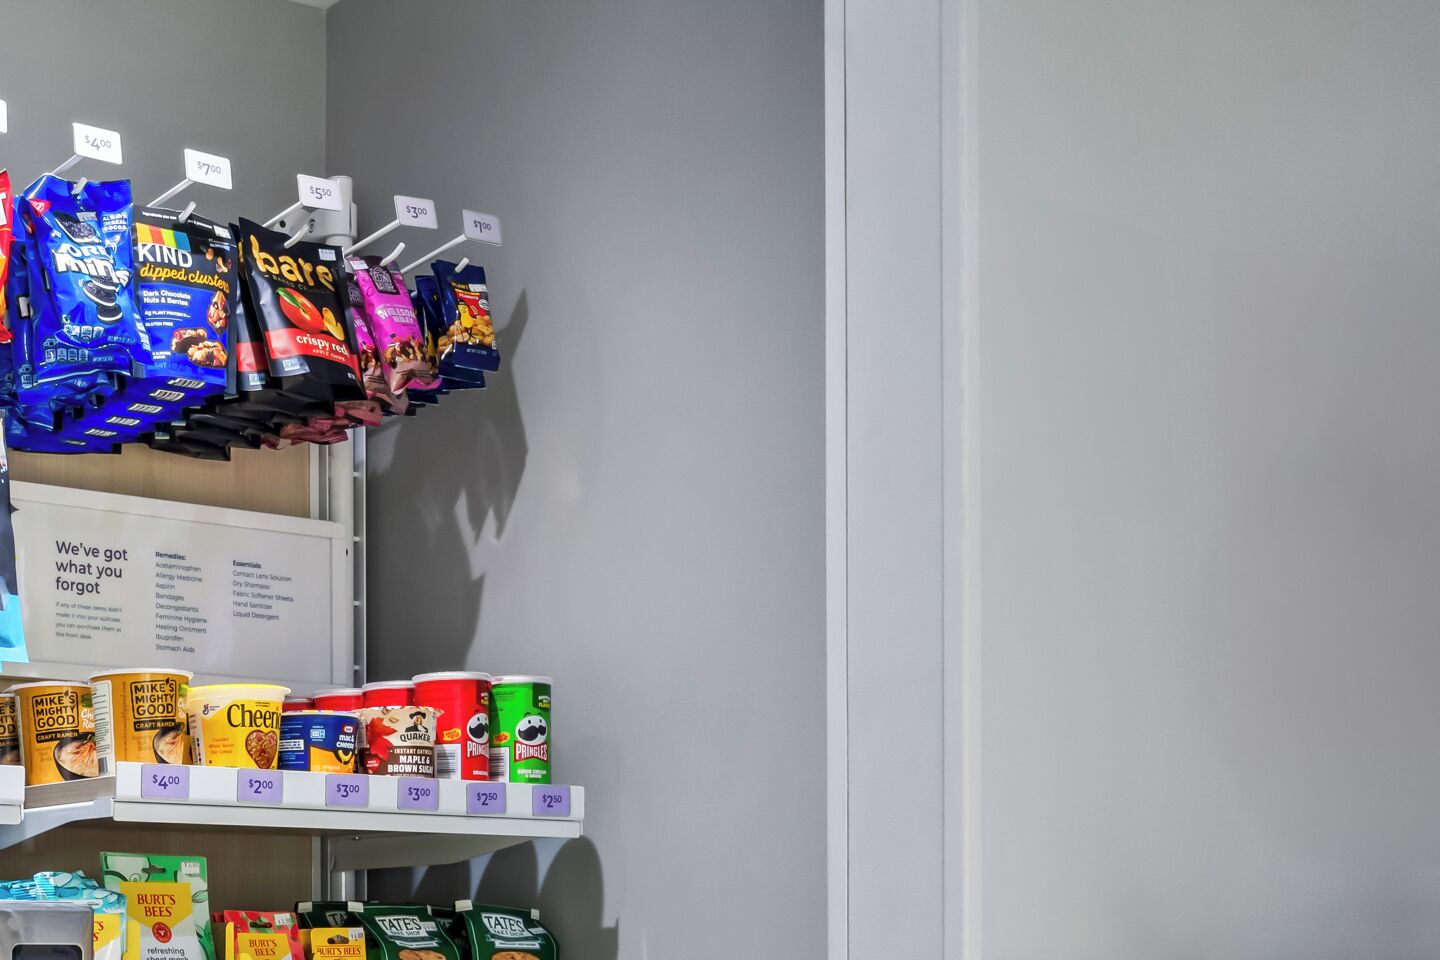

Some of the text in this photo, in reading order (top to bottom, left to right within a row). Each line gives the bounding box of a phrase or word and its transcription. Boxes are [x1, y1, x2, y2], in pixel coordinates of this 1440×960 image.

[138, 244, 192, 267] KIND
[250, 234, 335, 293] bare
[140, 263, 187, 281] dipped
[161, 290, 191, 300] Chocolate
[167, 298, 188, 306] Berries
[296, 334, 348, 354] crispy red
[56, 540, 128, 562] We've got
[56, 560, 122, 579] what you
[56, 577, 100, 595] forgot
[133, 681, 174, 694] MIKE'S
[135, 693, 174, 705] MIGHTY
[136, 703, 174, 716] GOOD
[400, 733, 430, 743] QUAKER
[516, 743, 547, 760] PRINGLES
[400, 755, 425, 764] MAPLE
[388, 765, 417, 773] BROWN
[137, 893, 176, 905] BURT'S
[144, 905, 173, 917] BEES
[378, 917, 422, 930] TATE'S
[147, 947, 185, 957] refreshing
